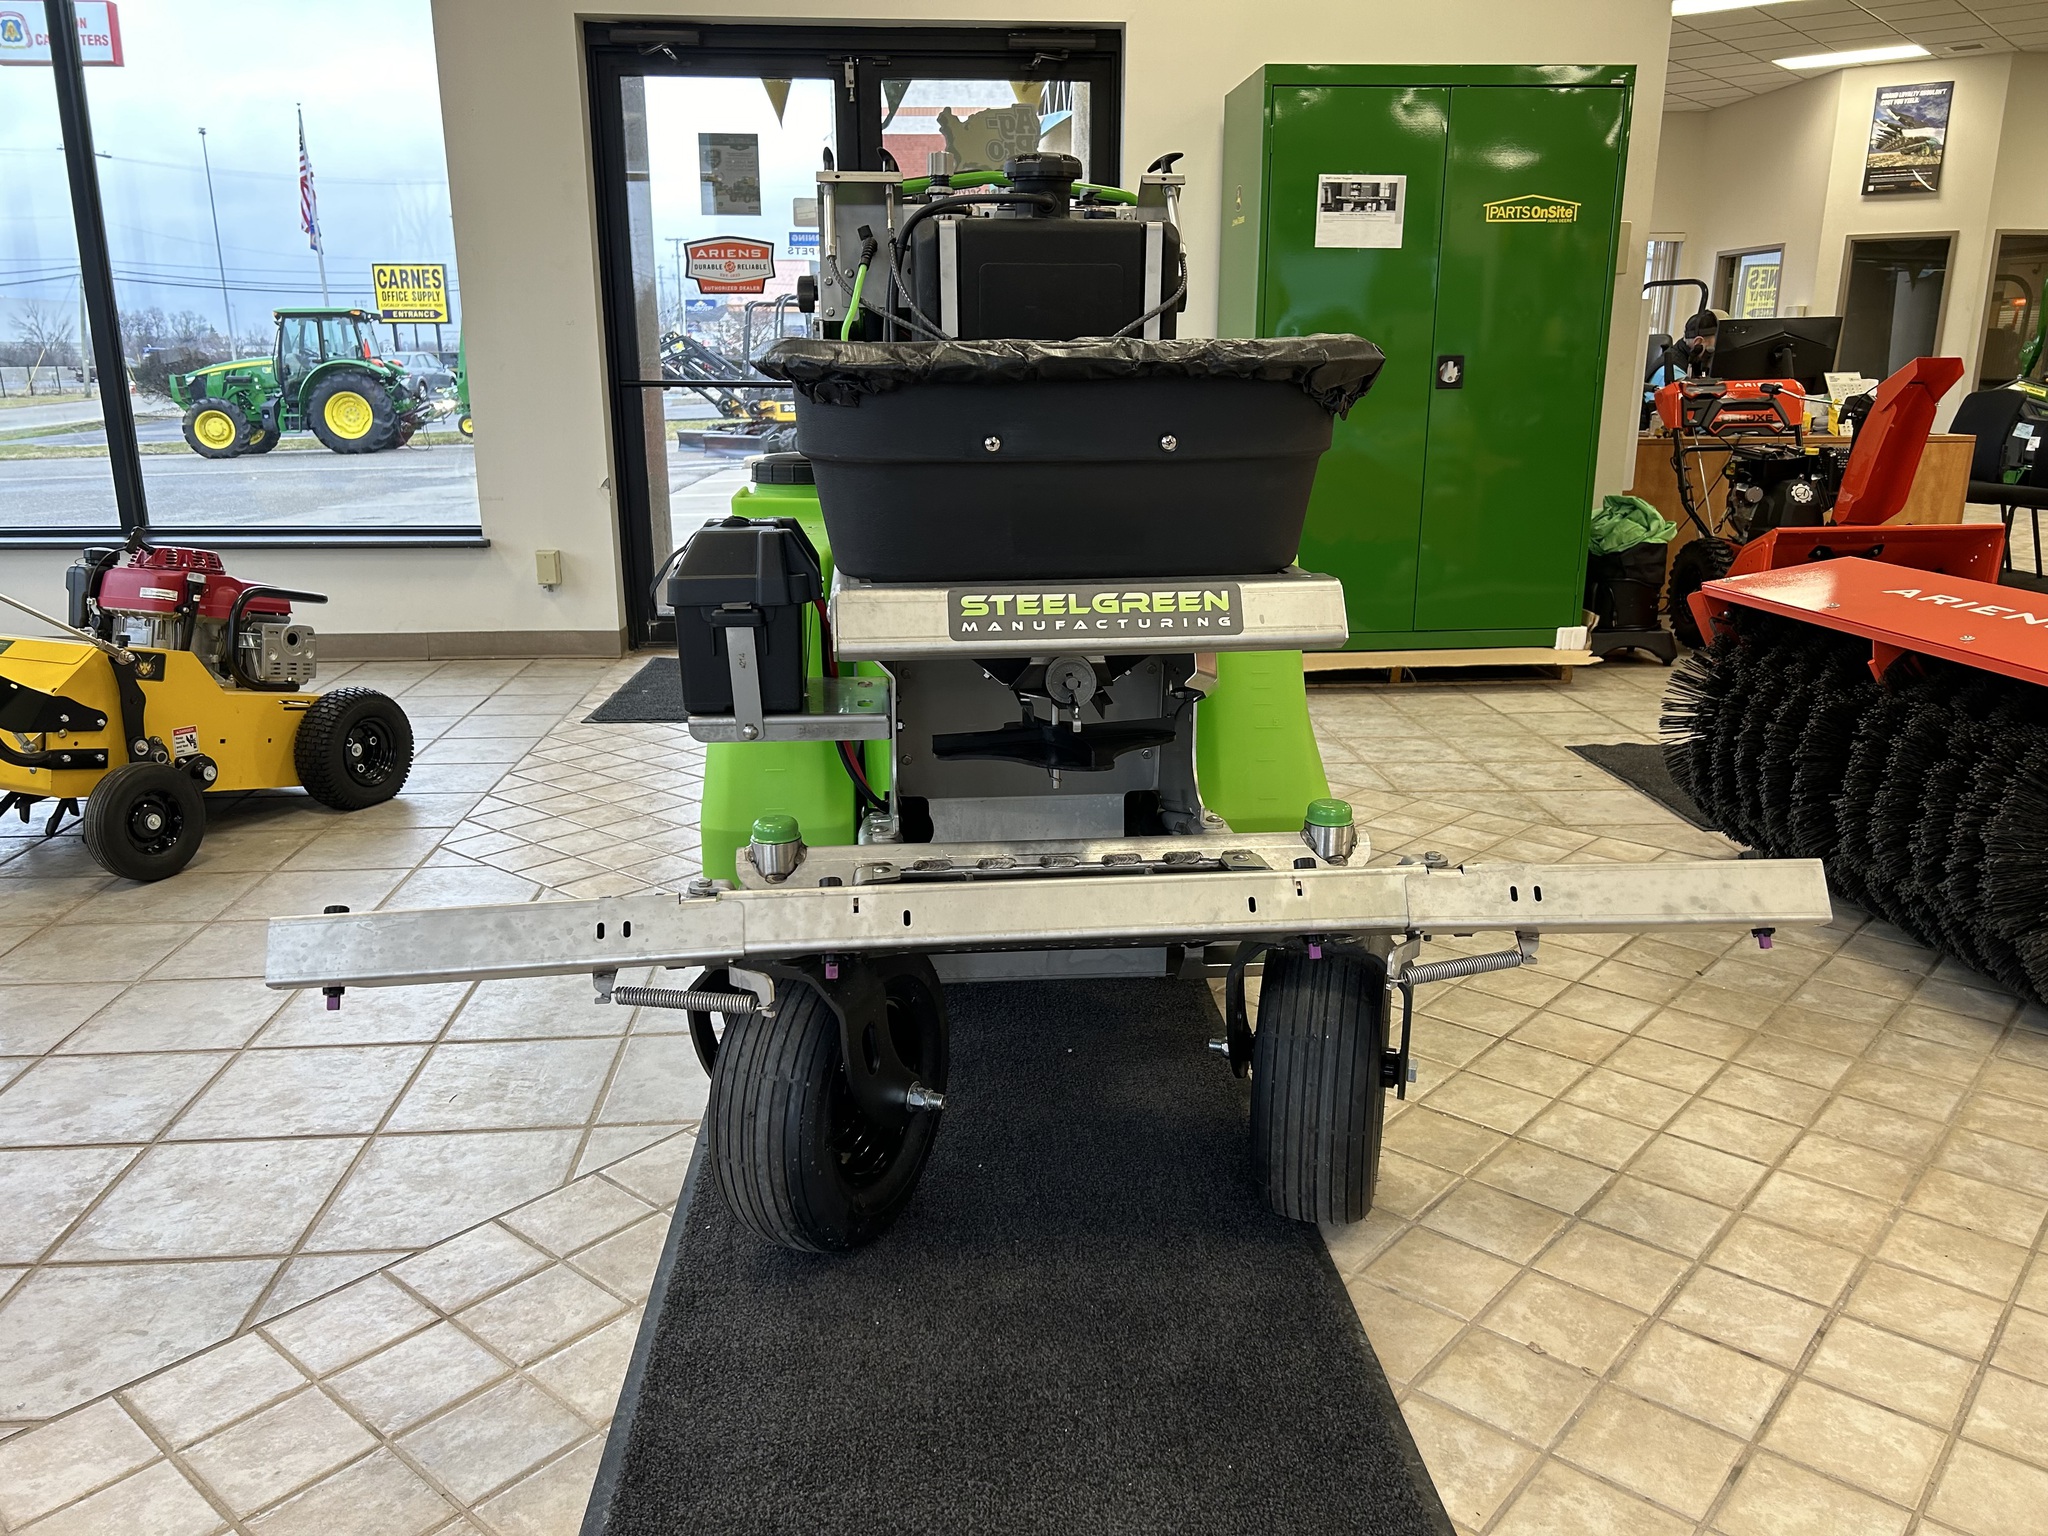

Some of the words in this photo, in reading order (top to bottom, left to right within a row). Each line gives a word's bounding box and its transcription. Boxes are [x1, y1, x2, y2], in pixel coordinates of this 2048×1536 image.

[35, 33, 109, 46] CATERS
[696, 249, 762, 258] ARIENS
[377, 268, 442, 290] CARNES
[382, 290, 409, 302] OFFICE
[412, 290, 441, 302] SUPPLY
[960, 590, 1230, 616] STEELGREEN
[1881, 589, 2048, 627] ARIEN
[961, 616, 1231, 632] MANUFACTURING
